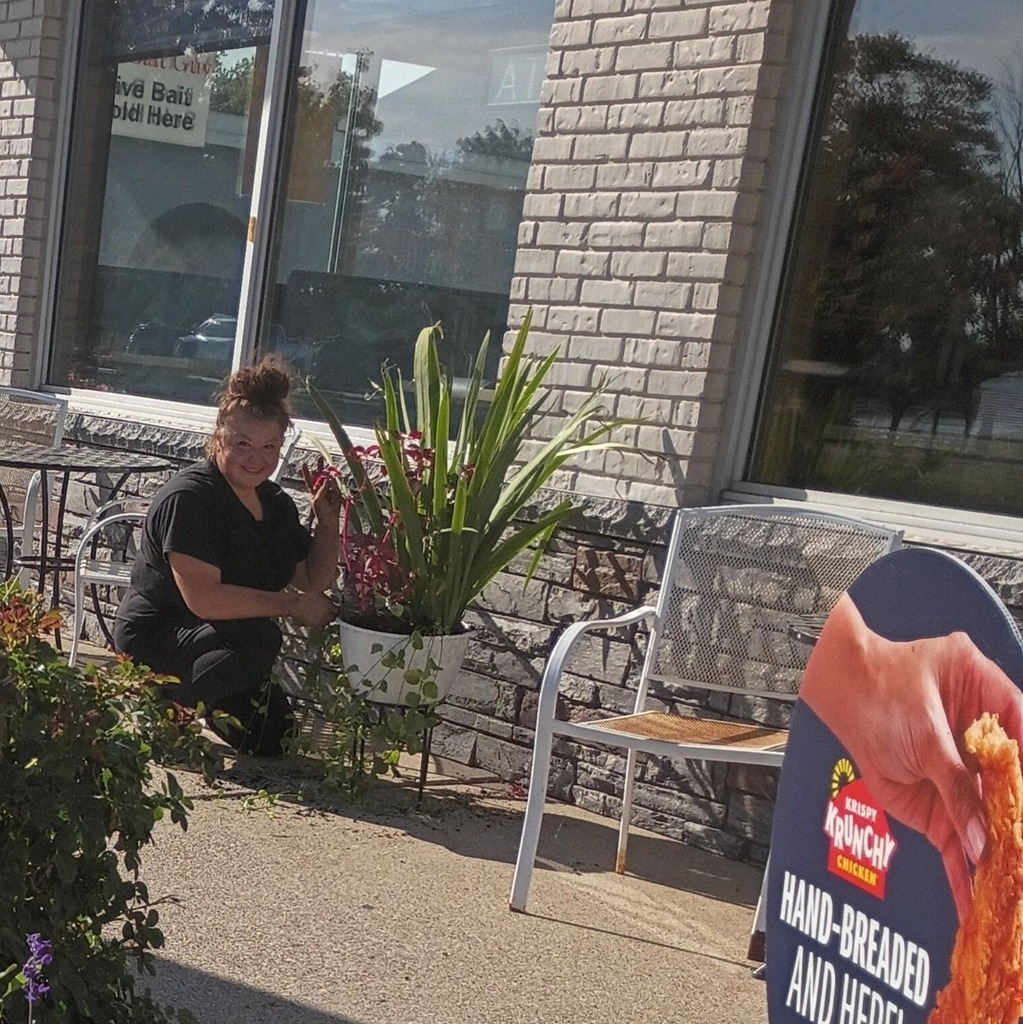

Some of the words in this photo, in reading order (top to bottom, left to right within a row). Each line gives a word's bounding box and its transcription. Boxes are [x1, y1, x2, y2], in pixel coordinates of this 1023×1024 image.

[115, 75, 144, 99] ive
[151, 81, 193, 106] Bait
[112, 101, 142, 123] old
[147, 104, 195, 131] Here
[844, 796, 877, 822] KRISPY
[824, 801, 896, 871] KRUNCHY
[836, 854, 877, 887] CHICKEN
[779, 870, 931, 1007] HAND-BREADED
